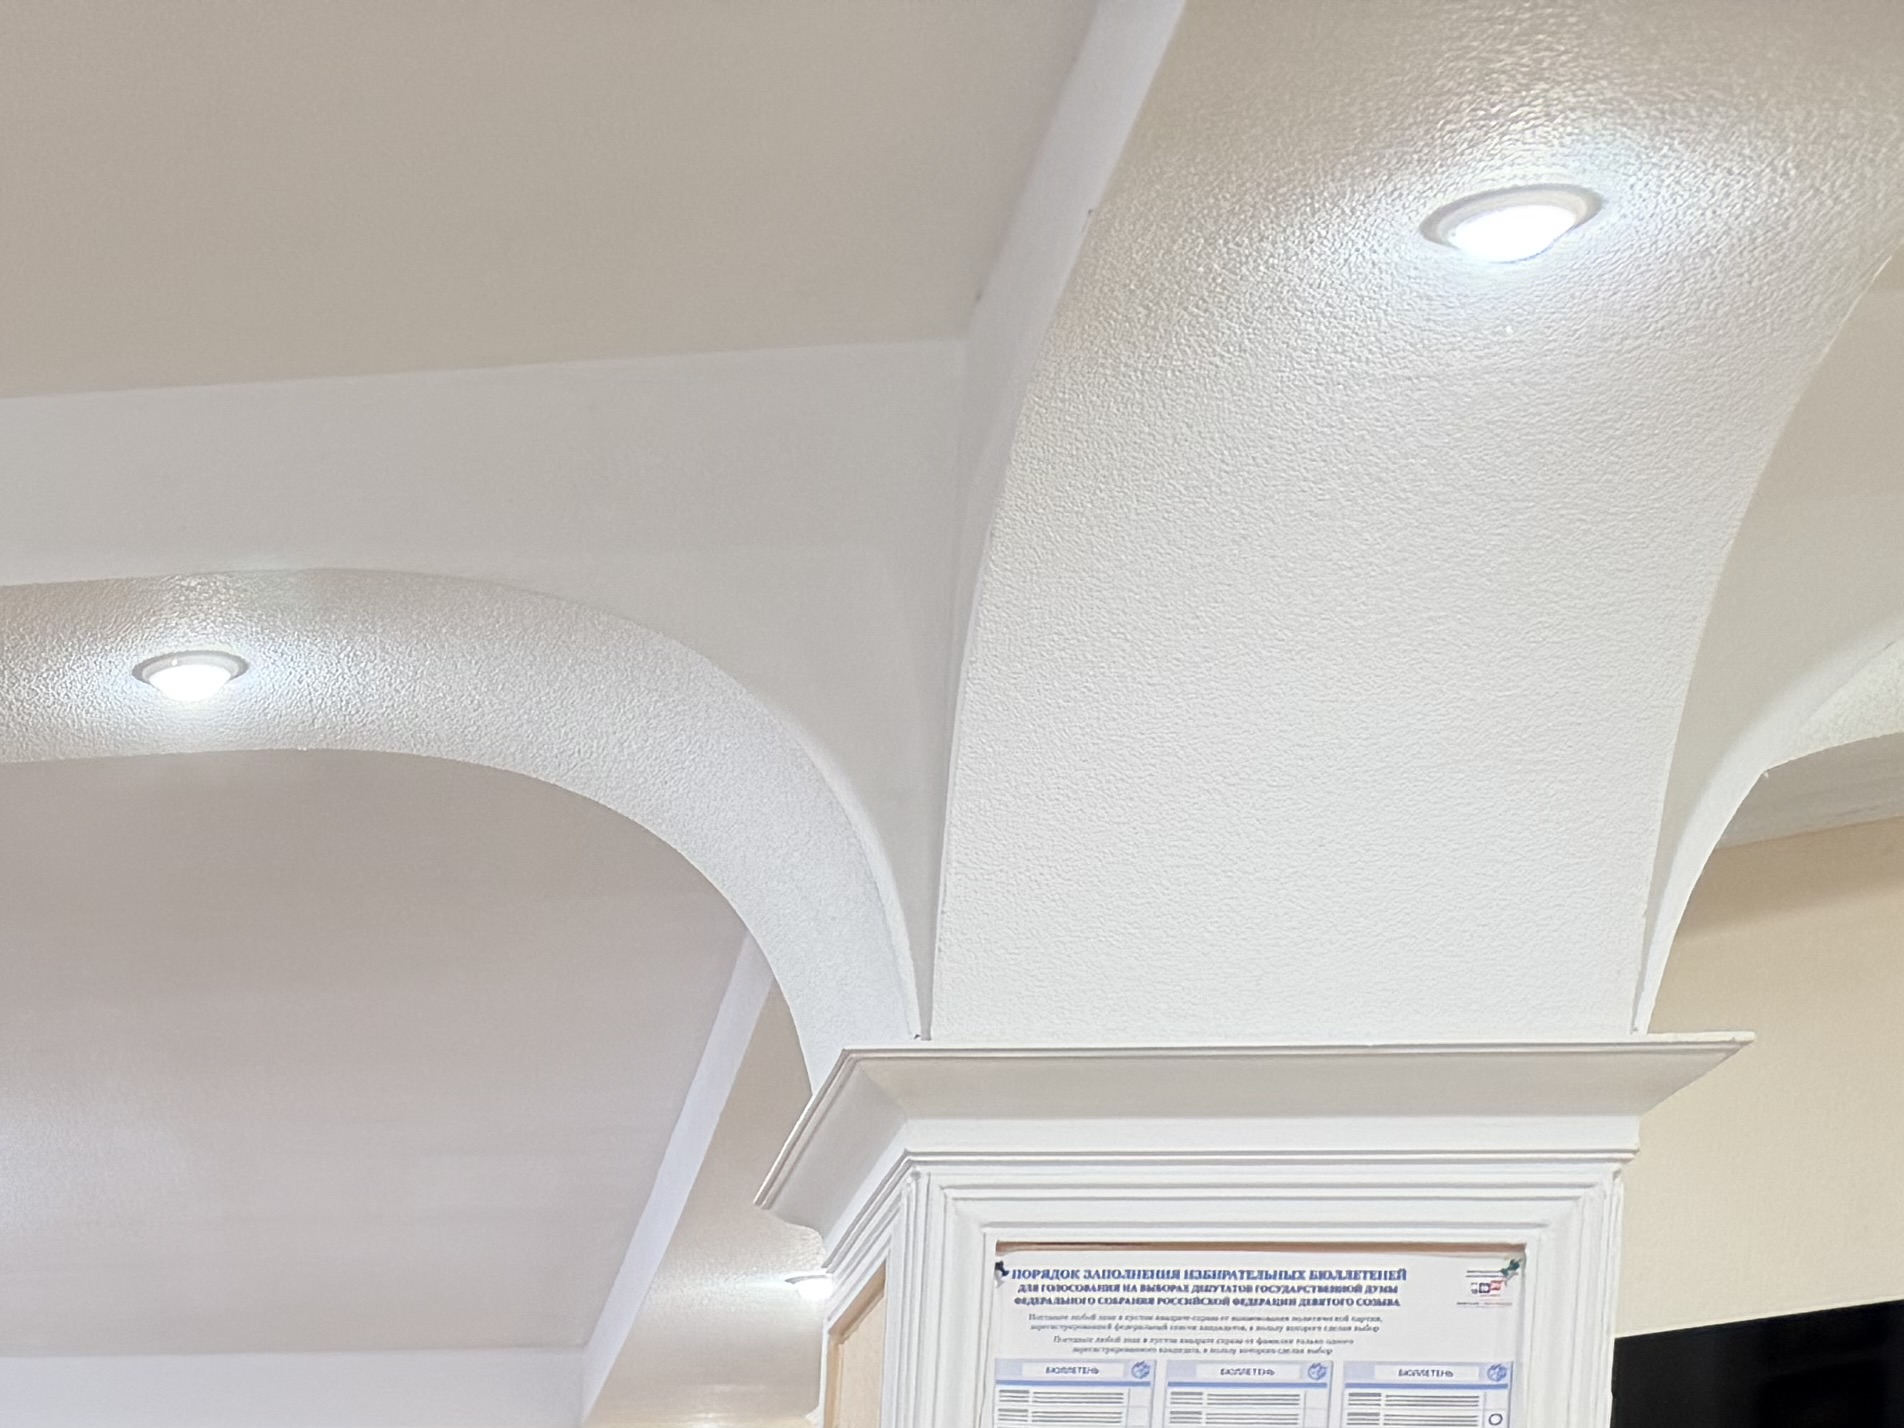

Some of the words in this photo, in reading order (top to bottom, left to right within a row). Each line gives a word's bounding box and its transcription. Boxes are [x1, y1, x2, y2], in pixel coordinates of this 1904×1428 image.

[1011, 1269, 1080, 1280] ПОРЯДОК
[1083, 1268, 1180, 1280] ЗАПОЛНЕНИЯ
[1183, 1269, 1306, 1281] ИЗБИРАТЕЛЬНЫХ
[1309, 1267, 1407, 1281] БЮЛЛЕТЕНЕЙ
